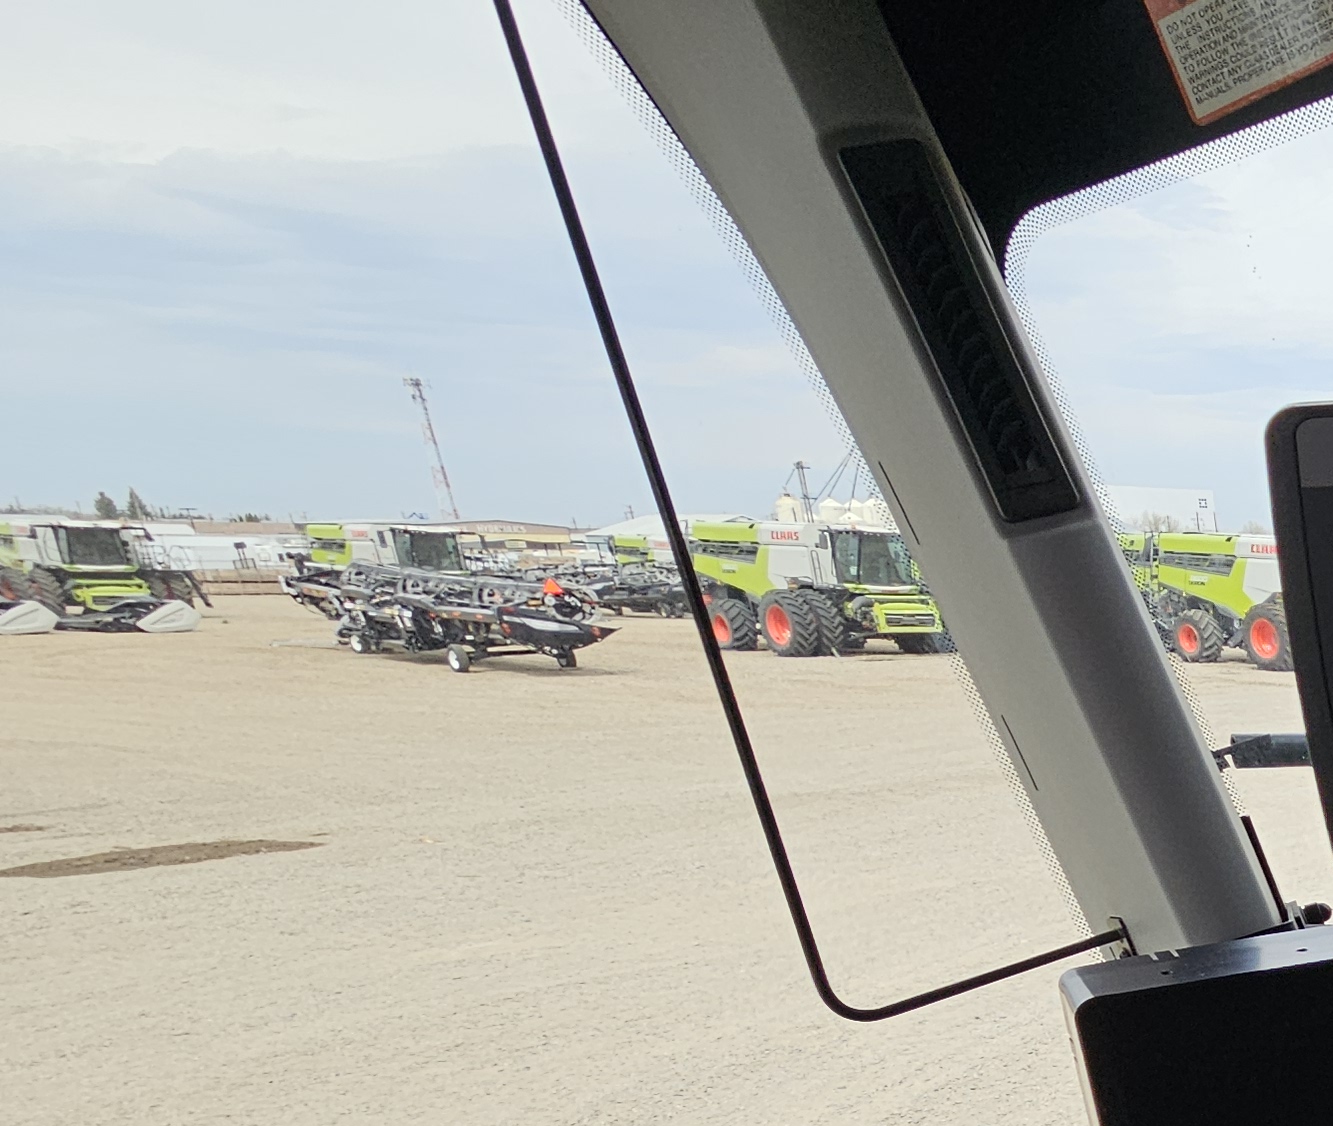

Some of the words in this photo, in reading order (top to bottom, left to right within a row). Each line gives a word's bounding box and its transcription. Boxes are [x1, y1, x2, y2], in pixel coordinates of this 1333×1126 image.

[1166, 21, 1180, 34] DO
[1180, 12, 1198, 27] NOT
[1170, 21, 1202, 45] UNLESS
[1205, 11, 1224, 26] YOU
[1175, 41, 1192, 55] THE
[1196, 7, 1256, 44] INSTRUCTIONS
[1179, 39, 1220, 65] OPERATION
[1220, 29, 1238, 44] AND
[1184, 63, 1196, 75] TO
[1196, 46, 1230, 69] FOLLOW
[1231, 37, 1248, 51] THE
[1187, 58, 1230, 85] WARNINGS
[1229, 44, 1258, 64] COULD
[1191, 72, 1227, 95] CONTACT
[1226, 64, 1244, 77] ANY
[1268, 35, 1300, 57] DEALER
[1232, 64, 1265, 86] PROPER
[1264, 54, 1286, 71] CARE
[770, 530, 800, 541] CLAAS
